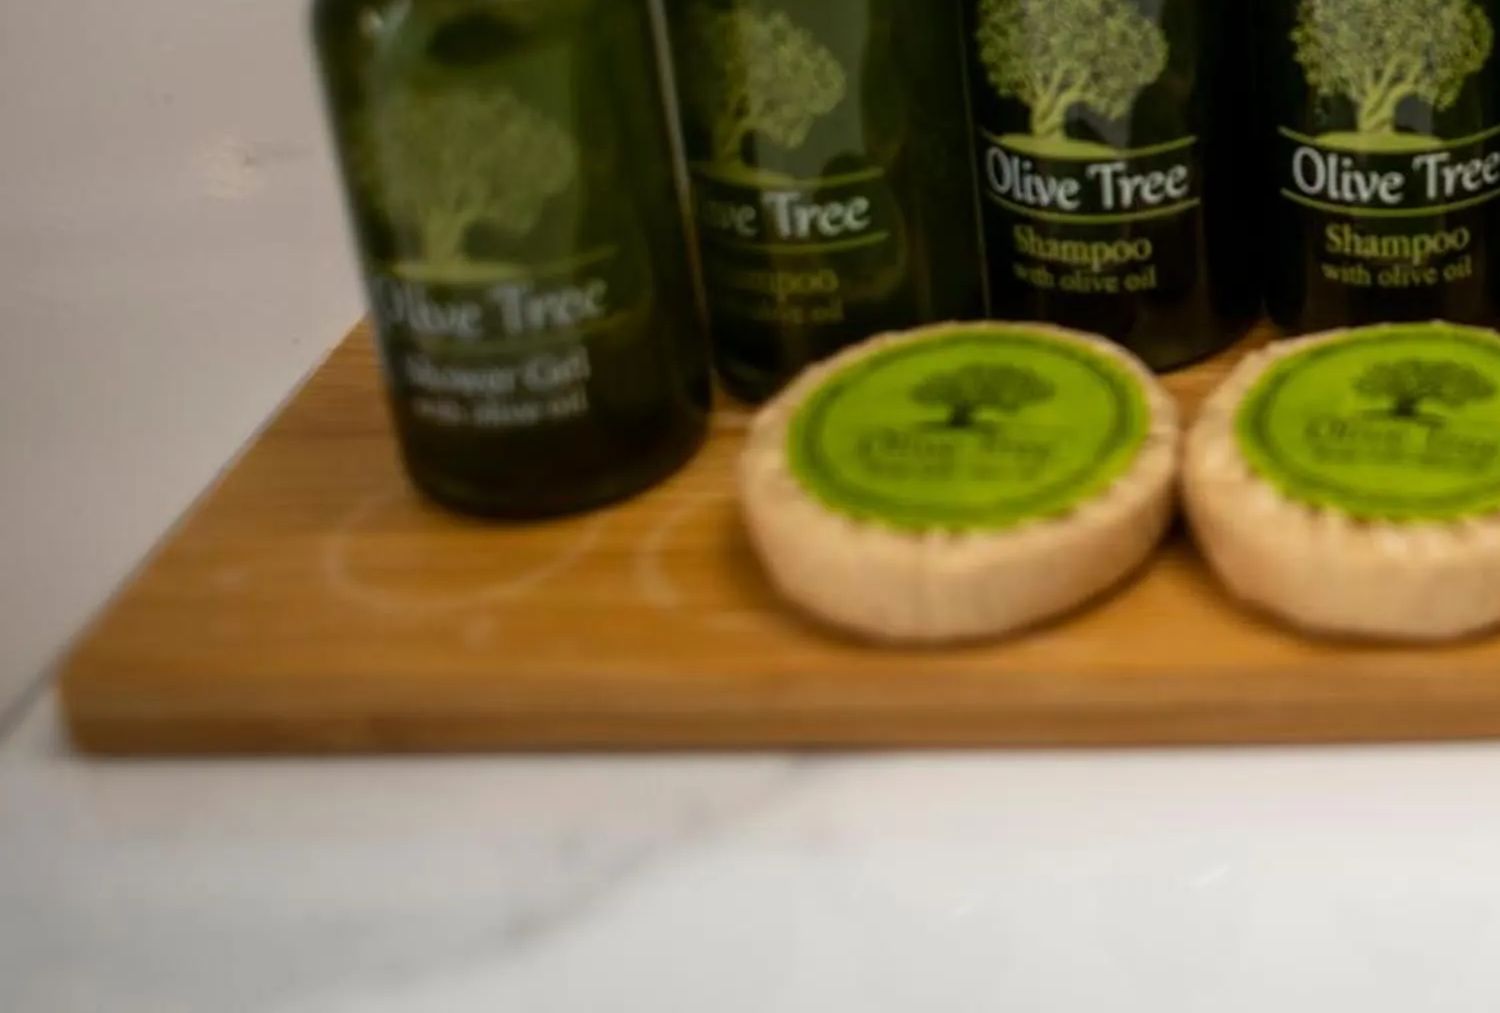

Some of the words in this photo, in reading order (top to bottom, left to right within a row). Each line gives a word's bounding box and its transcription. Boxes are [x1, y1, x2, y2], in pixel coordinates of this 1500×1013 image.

[985, 146, 1082, 211] Olive
[1085, 160, 1190, 211] Tree
[1292, 146, 1406, 206] Olive
[760, 191, 871, 240] Tree
[1012, 223, 1153, 273] Shampoo
[1324, 222, 1471, 266] Shampoo
